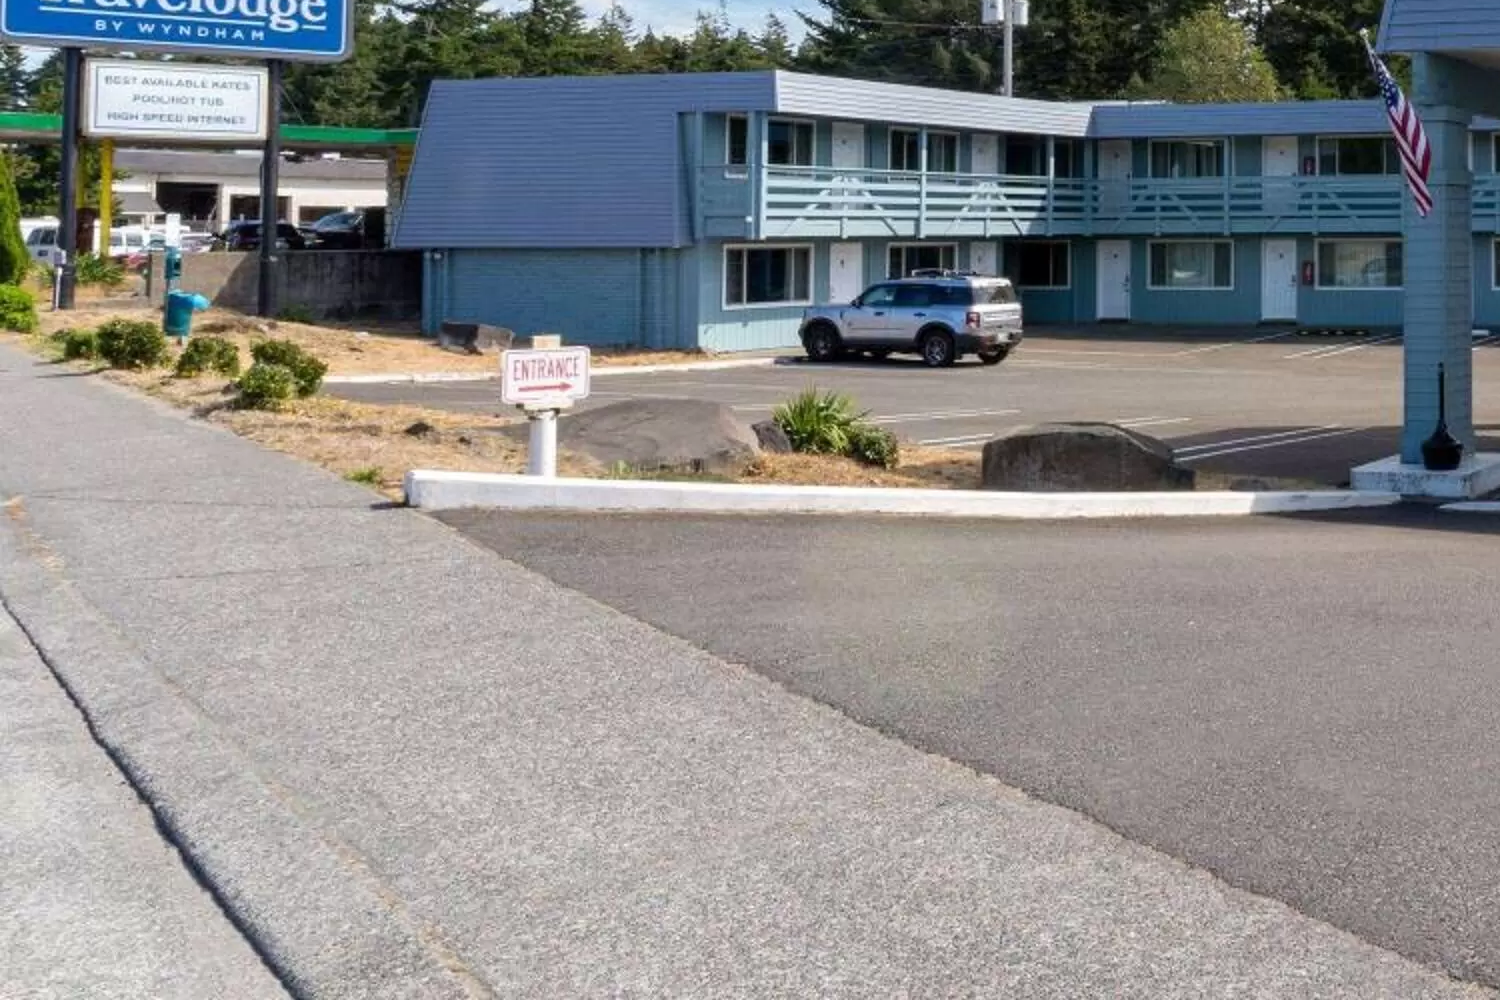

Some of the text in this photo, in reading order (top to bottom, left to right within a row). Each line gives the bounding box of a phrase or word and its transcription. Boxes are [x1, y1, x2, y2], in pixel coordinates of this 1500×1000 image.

[95, 19, 265, 41] BY WYNDHAM
[141, 76, 208, 89] AVAILABLE
[212, 79, 251, 91] RATES
[107, 111, 247, 125] HIGH SPEED INTERNET
[513, 356, 580, 381] ENTRANCE
